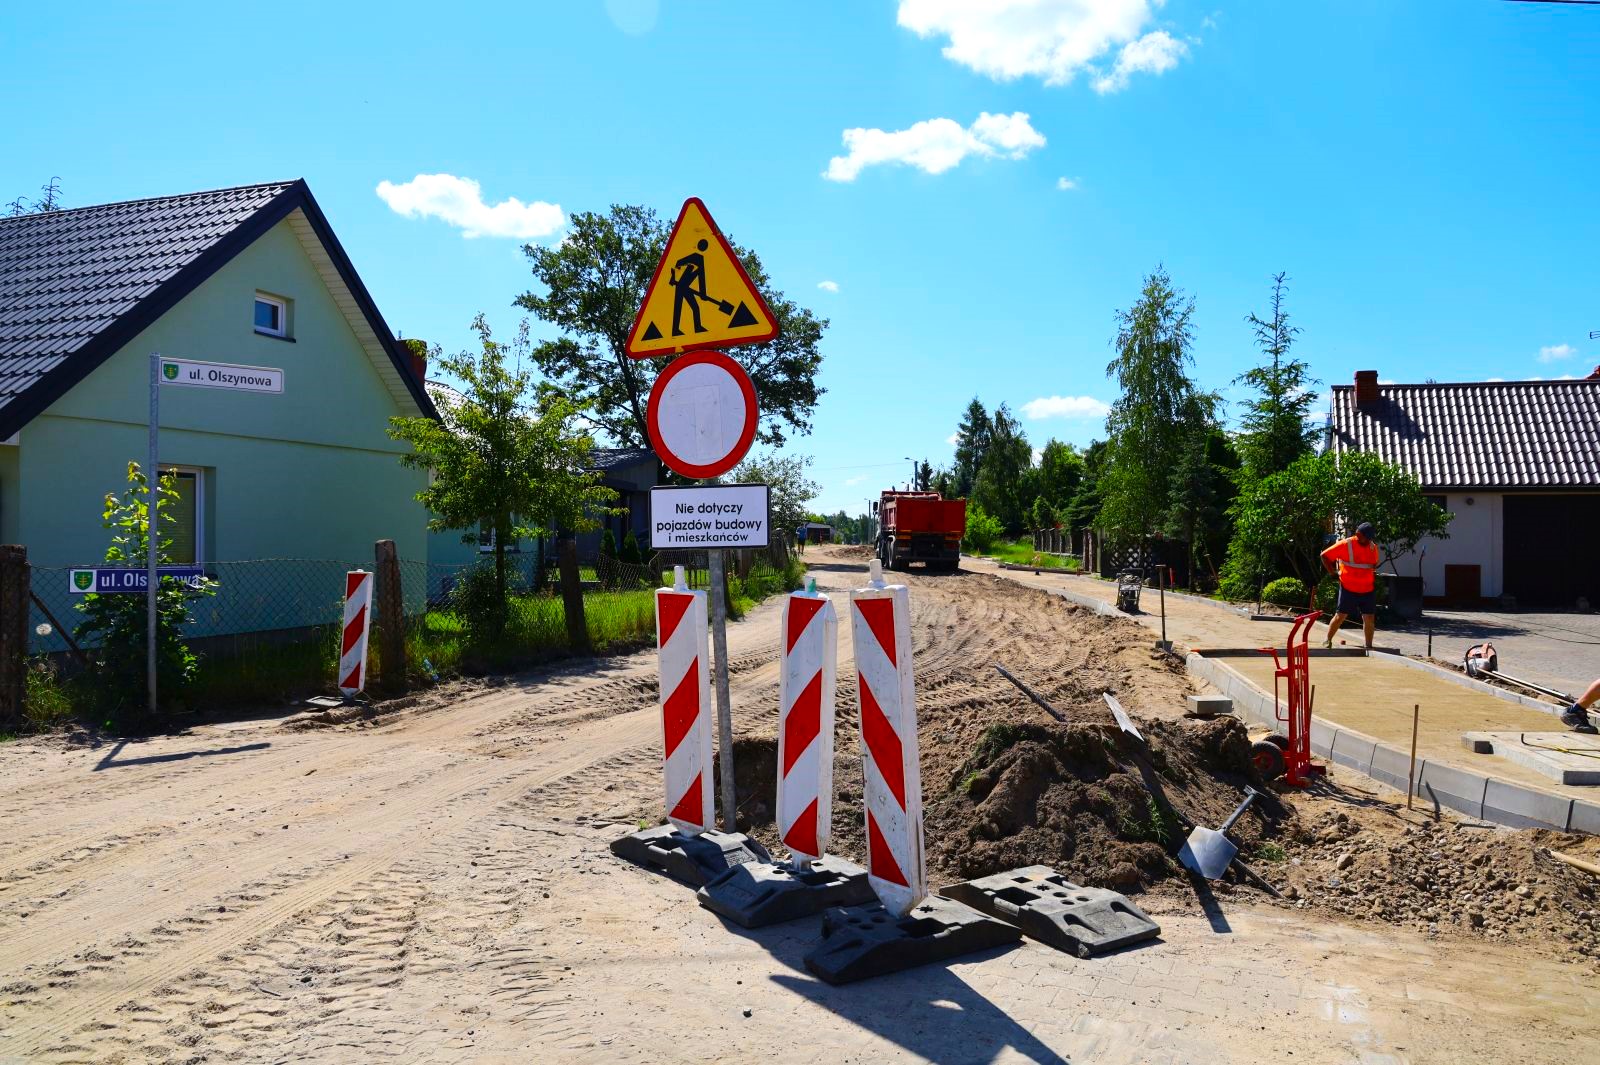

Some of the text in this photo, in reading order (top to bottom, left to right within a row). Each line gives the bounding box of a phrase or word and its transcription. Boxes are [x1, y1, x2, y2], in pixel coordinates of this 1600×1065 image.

[189, 369, 272, 386] ul. Olszynowa
[675, 502, 743, 515] Nie dotyczy
[656, 519, 762, 533] pojazdów budowy
[668, 532, 749, 542] i mieszkańców
[101, 573, 199, 589] ul. Olsyowa
